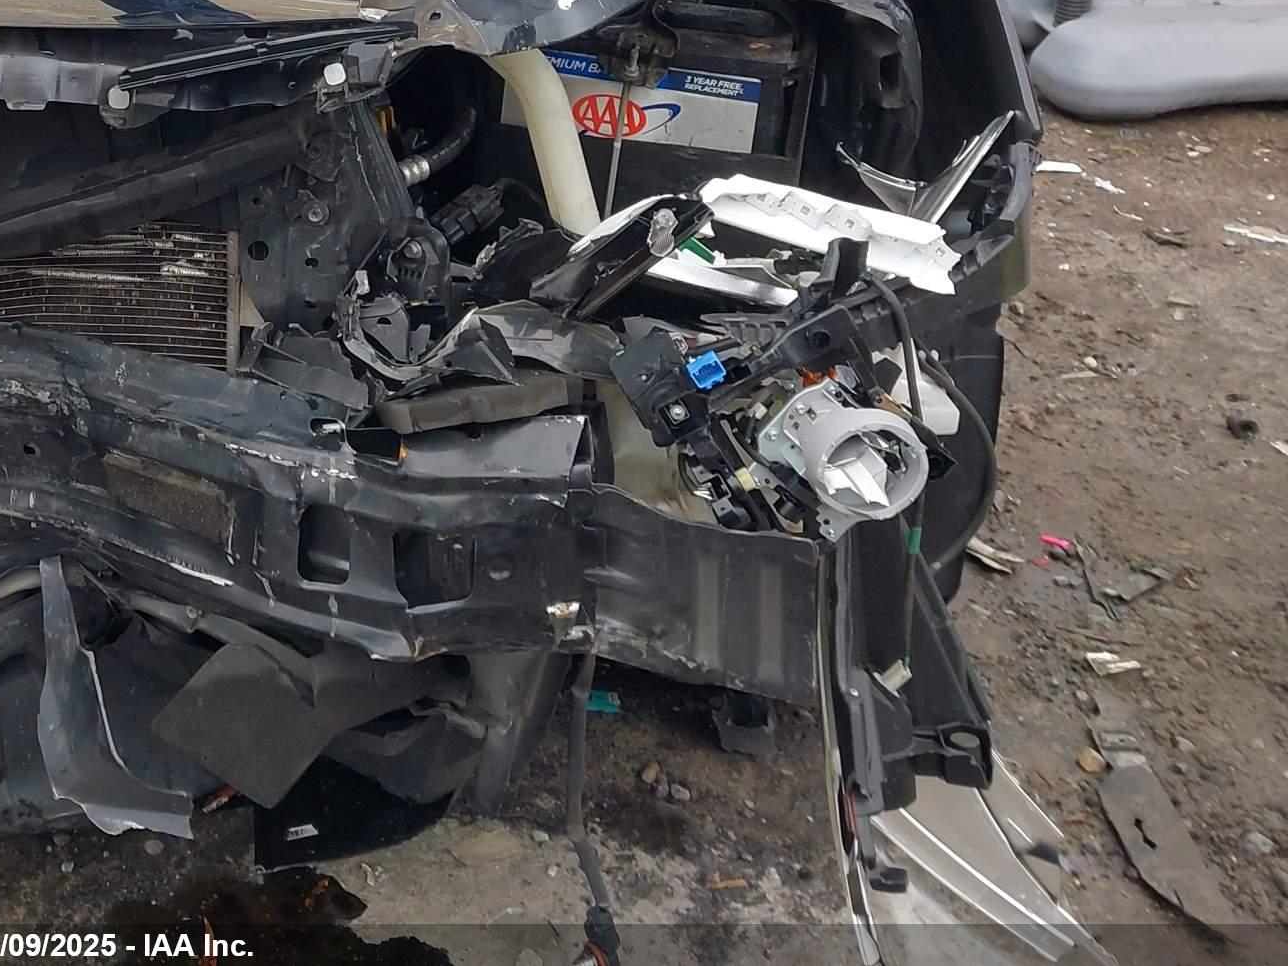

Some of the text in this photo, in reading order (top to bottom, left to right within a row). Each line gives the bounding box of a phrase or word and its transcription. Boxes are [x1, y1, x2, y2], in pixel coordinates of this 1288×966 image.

[546, 56, 601, 74] MIUM B
[685, 75, 743, 90] 3 YEAR FREE
[578, 95, 640, 135] AAA
